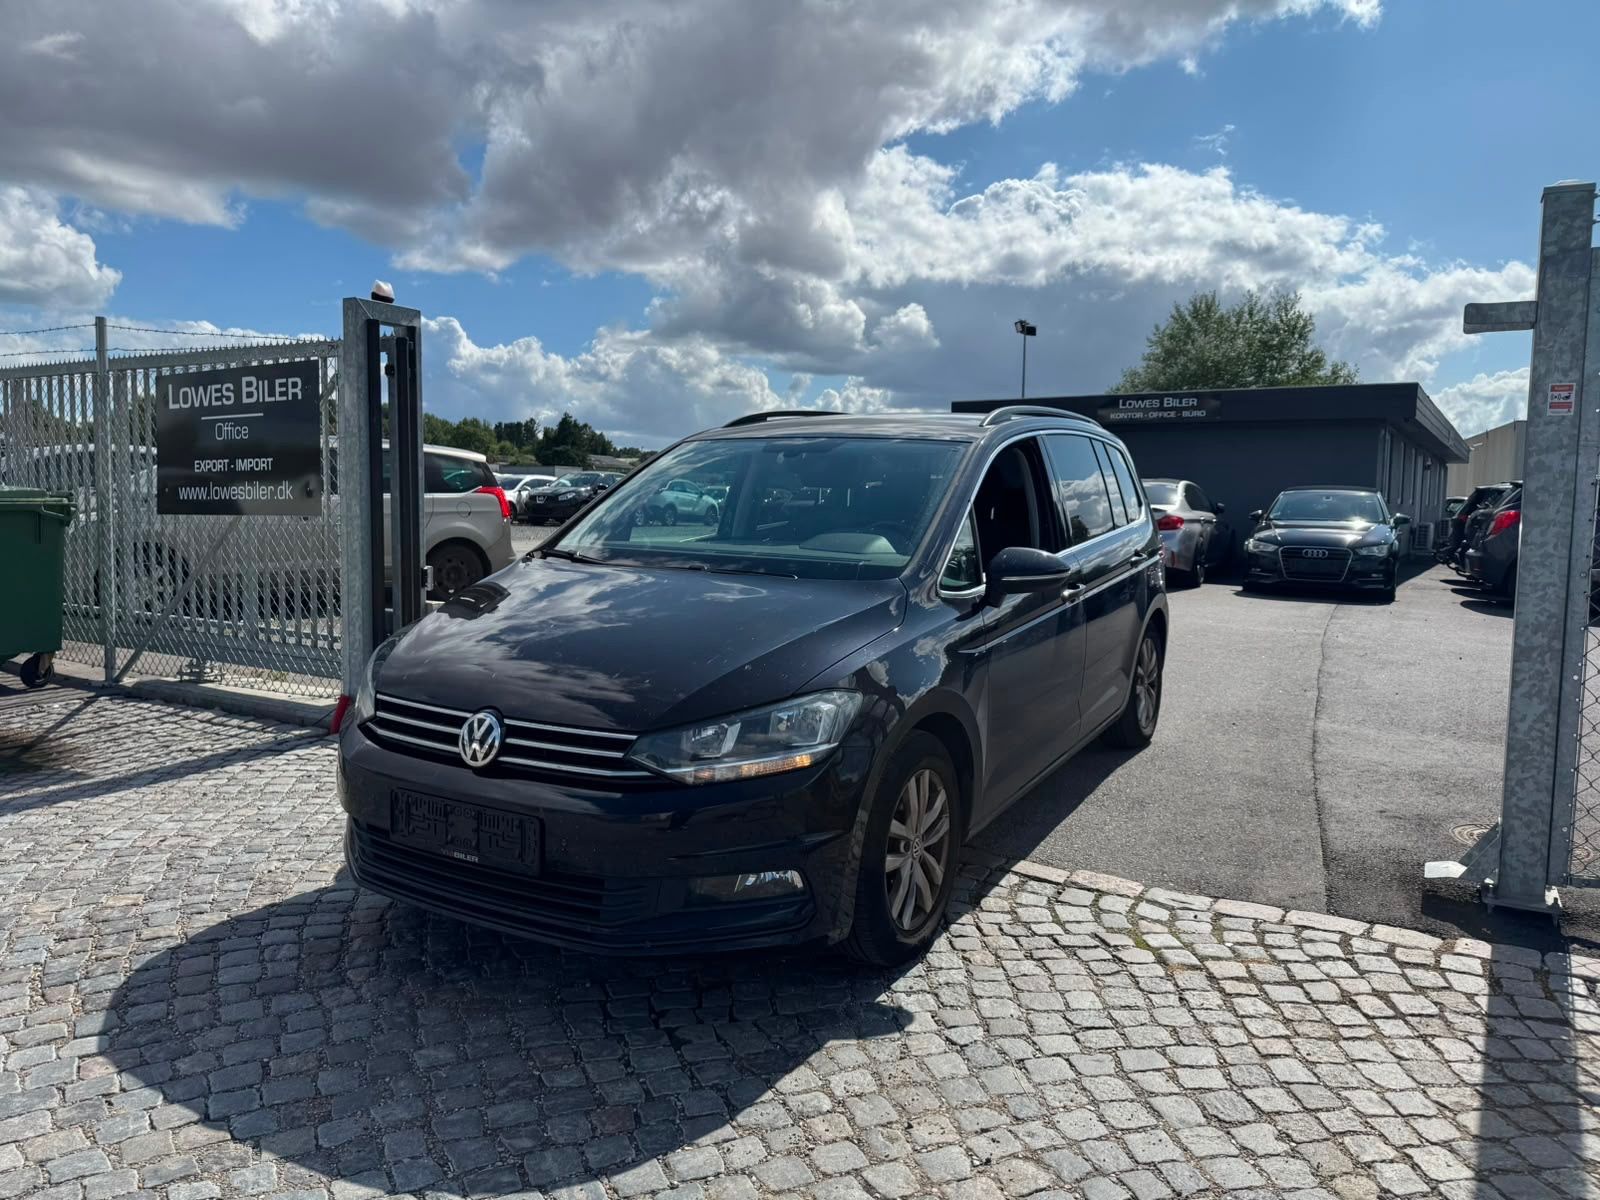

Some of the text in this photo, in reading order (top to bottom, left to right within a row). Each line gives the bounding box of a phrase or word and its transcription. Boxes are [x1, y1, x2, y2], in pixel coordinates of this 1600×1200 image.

[168, 376, 302, 410] LOWES BILER
[1119, 397, 1198, 409] LOWES BILER
[215, 422, 249, 440] Office
[194, 459, 229, 473] EXPORT
[235, 458, 273, 471] IMPORT
[178, 480, 293, 500] www.lowesbiler.dk
